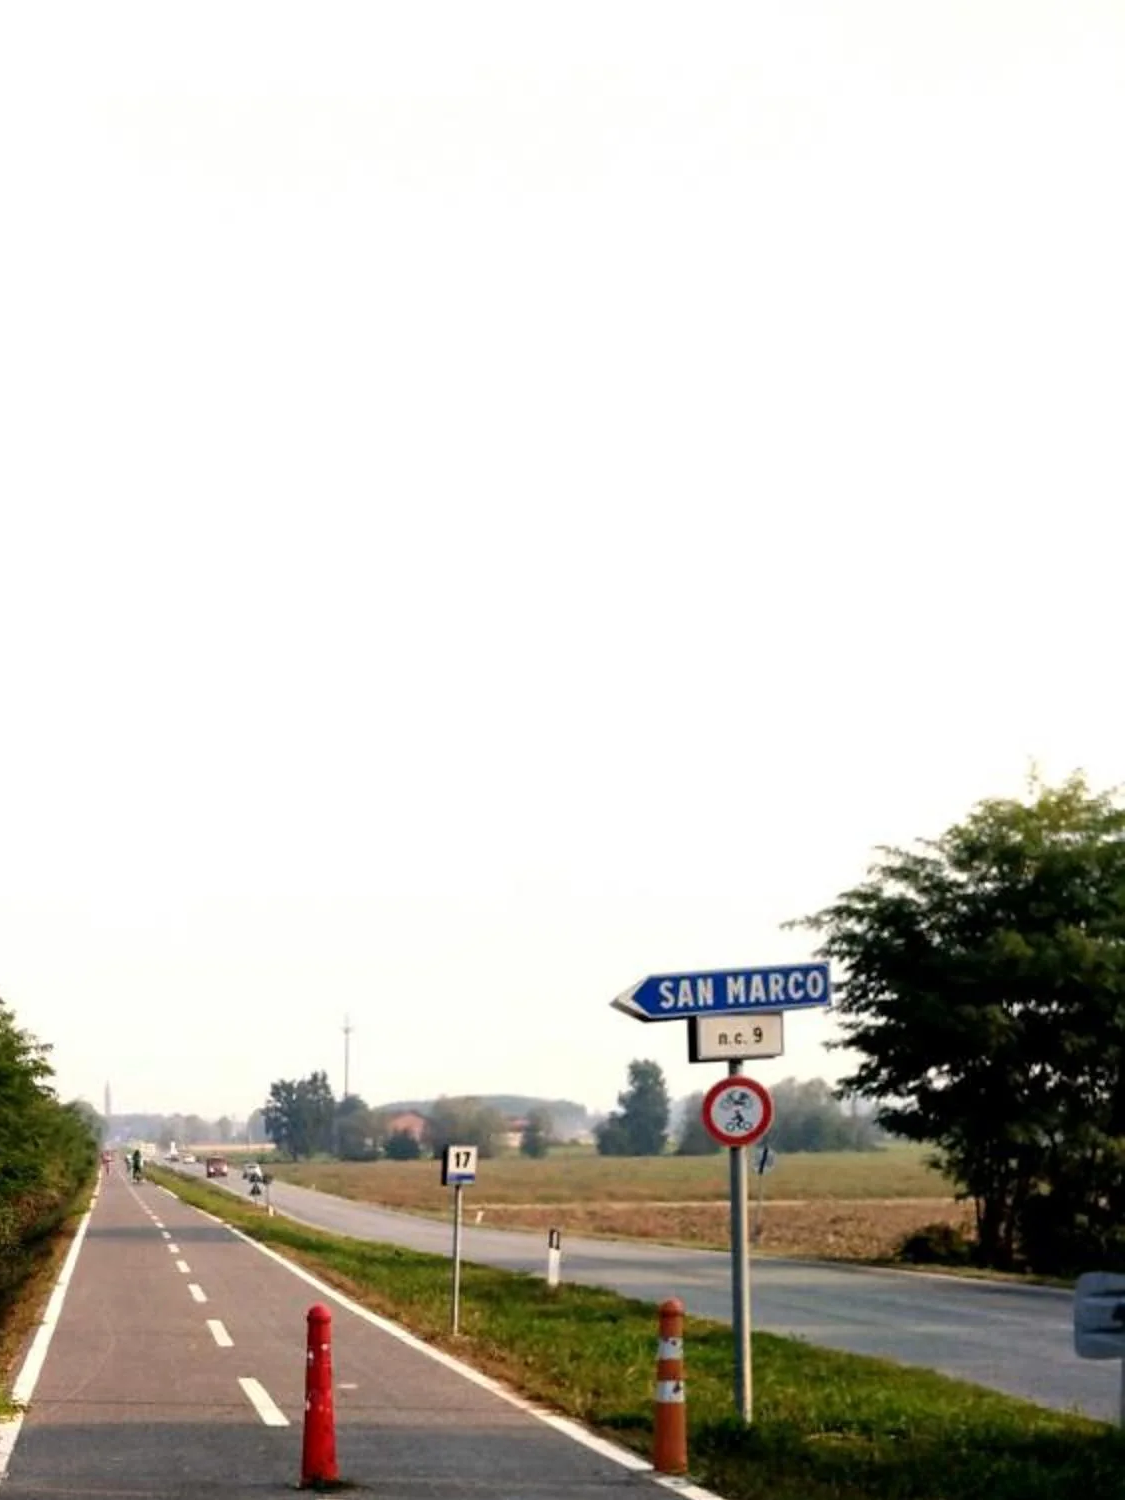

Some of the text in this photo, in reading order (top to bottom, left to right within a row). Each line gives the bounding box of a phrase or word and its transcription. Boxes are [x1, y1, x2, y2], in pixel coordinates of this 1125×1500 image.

[659, 970, 824, 1009] SAN MARCO
[753, 1027, 764, 1044] 9
[456, 1151, 471, 1169] 17
